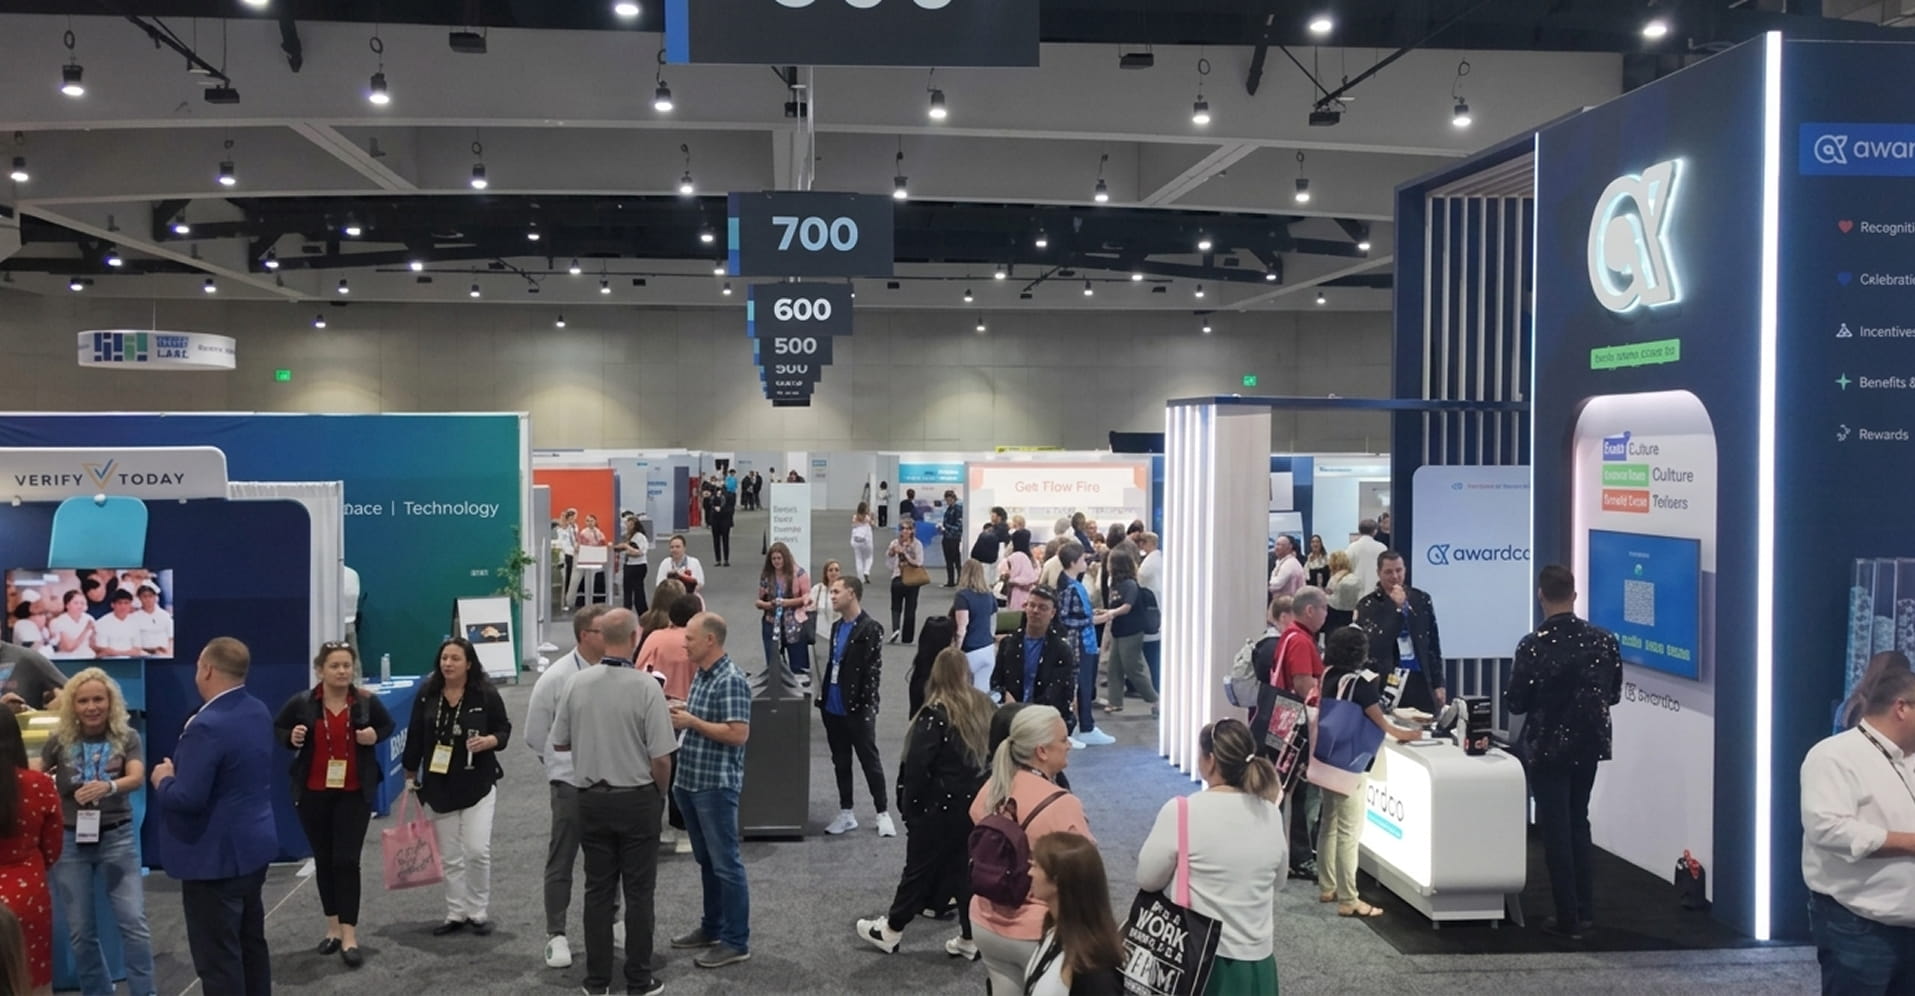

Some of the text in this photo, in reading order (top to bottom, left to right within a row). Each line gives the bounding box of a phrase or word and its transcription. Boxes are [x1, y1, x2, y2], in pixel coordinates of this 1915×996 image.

[772, 216, 858, 251] 700
[774, 298, 832, 321] 600
[775, 337, 817, 354] 500
[1859, 376, 1906, 389] Benefits
[1859, 428, 1909, 440] Rewards
[15, 473, 185, 486] VERIFY TODAY
[1652, 467, 1694, 482] Culture
[403, 501, 499, 517] Technology
